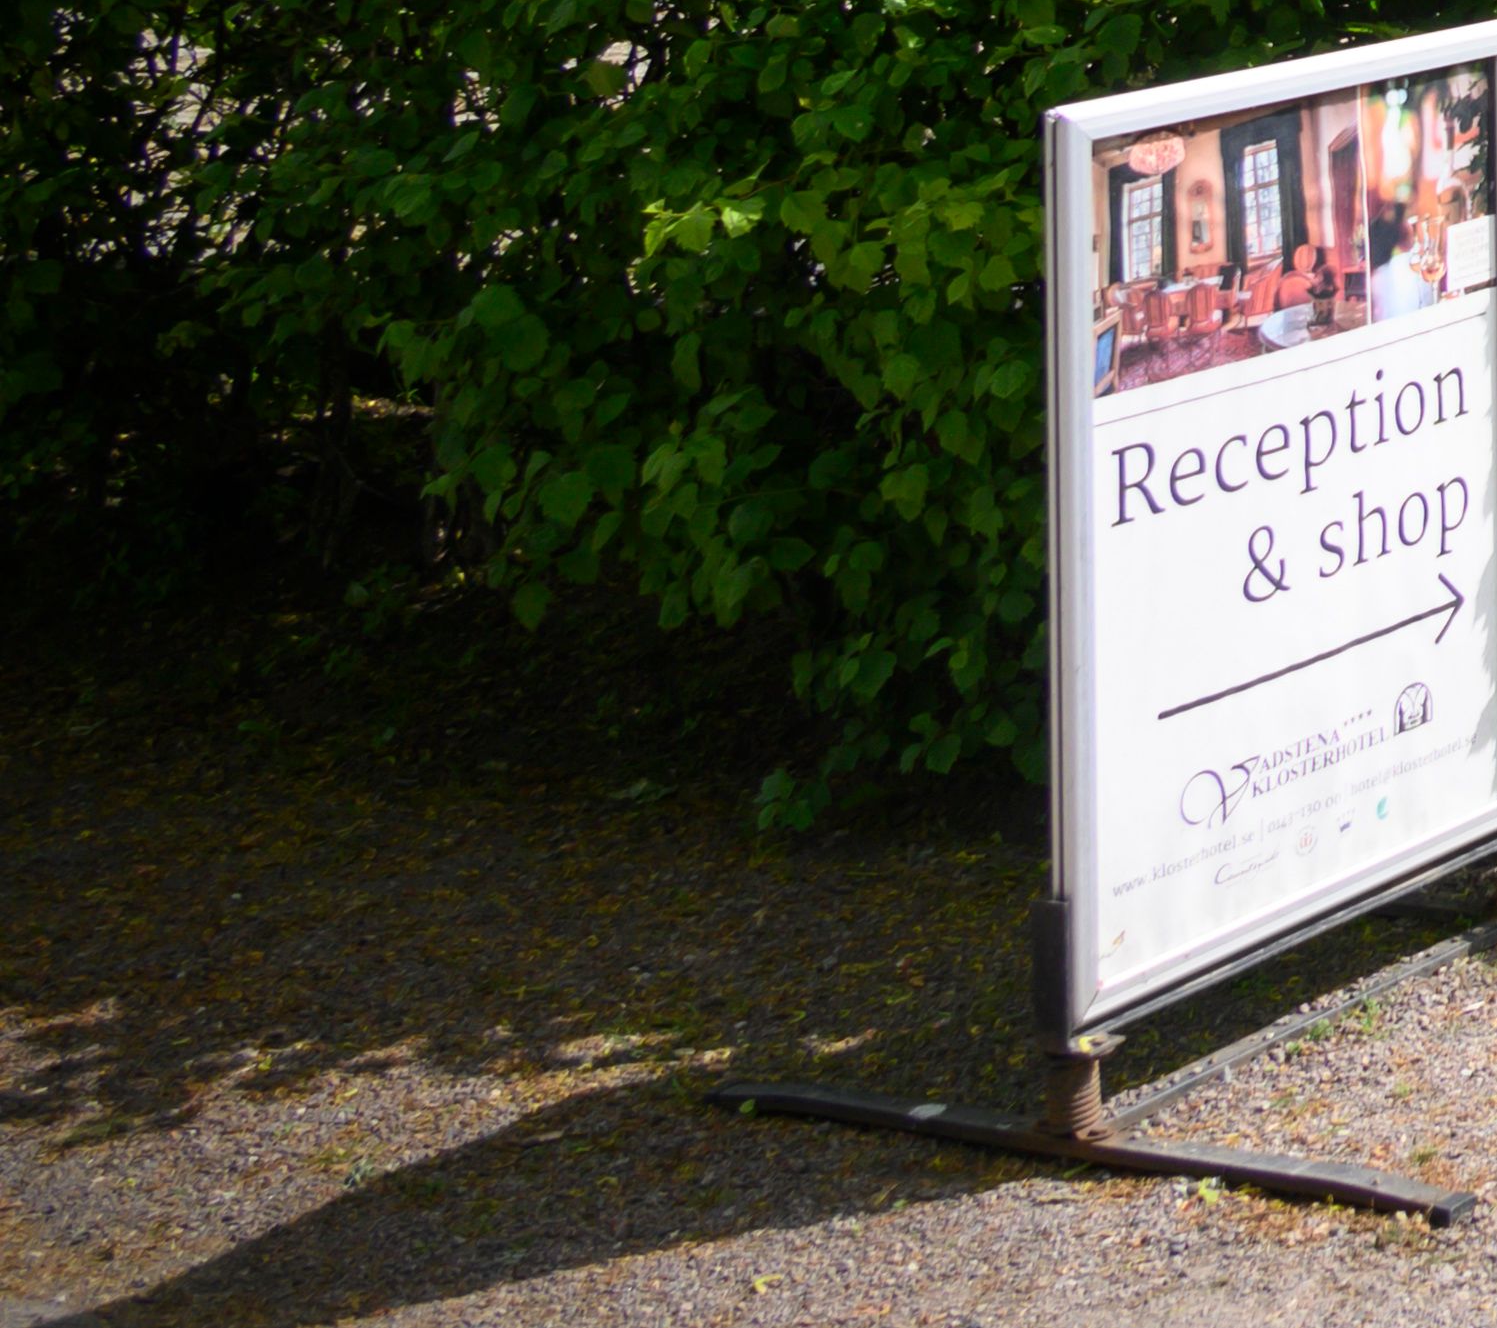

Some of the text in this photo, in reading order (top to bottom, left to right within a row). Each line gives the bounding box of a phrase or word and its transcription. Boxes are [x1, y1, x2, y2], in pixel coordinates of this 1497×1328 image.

[1110, 367, 1470, 527] Reception
[1242, 476, 1469, 603] & shop
[1180, 729, 1341, 830] VADSTENA
[1251, 727, 1387, 799] KLOSTERHOTEL
